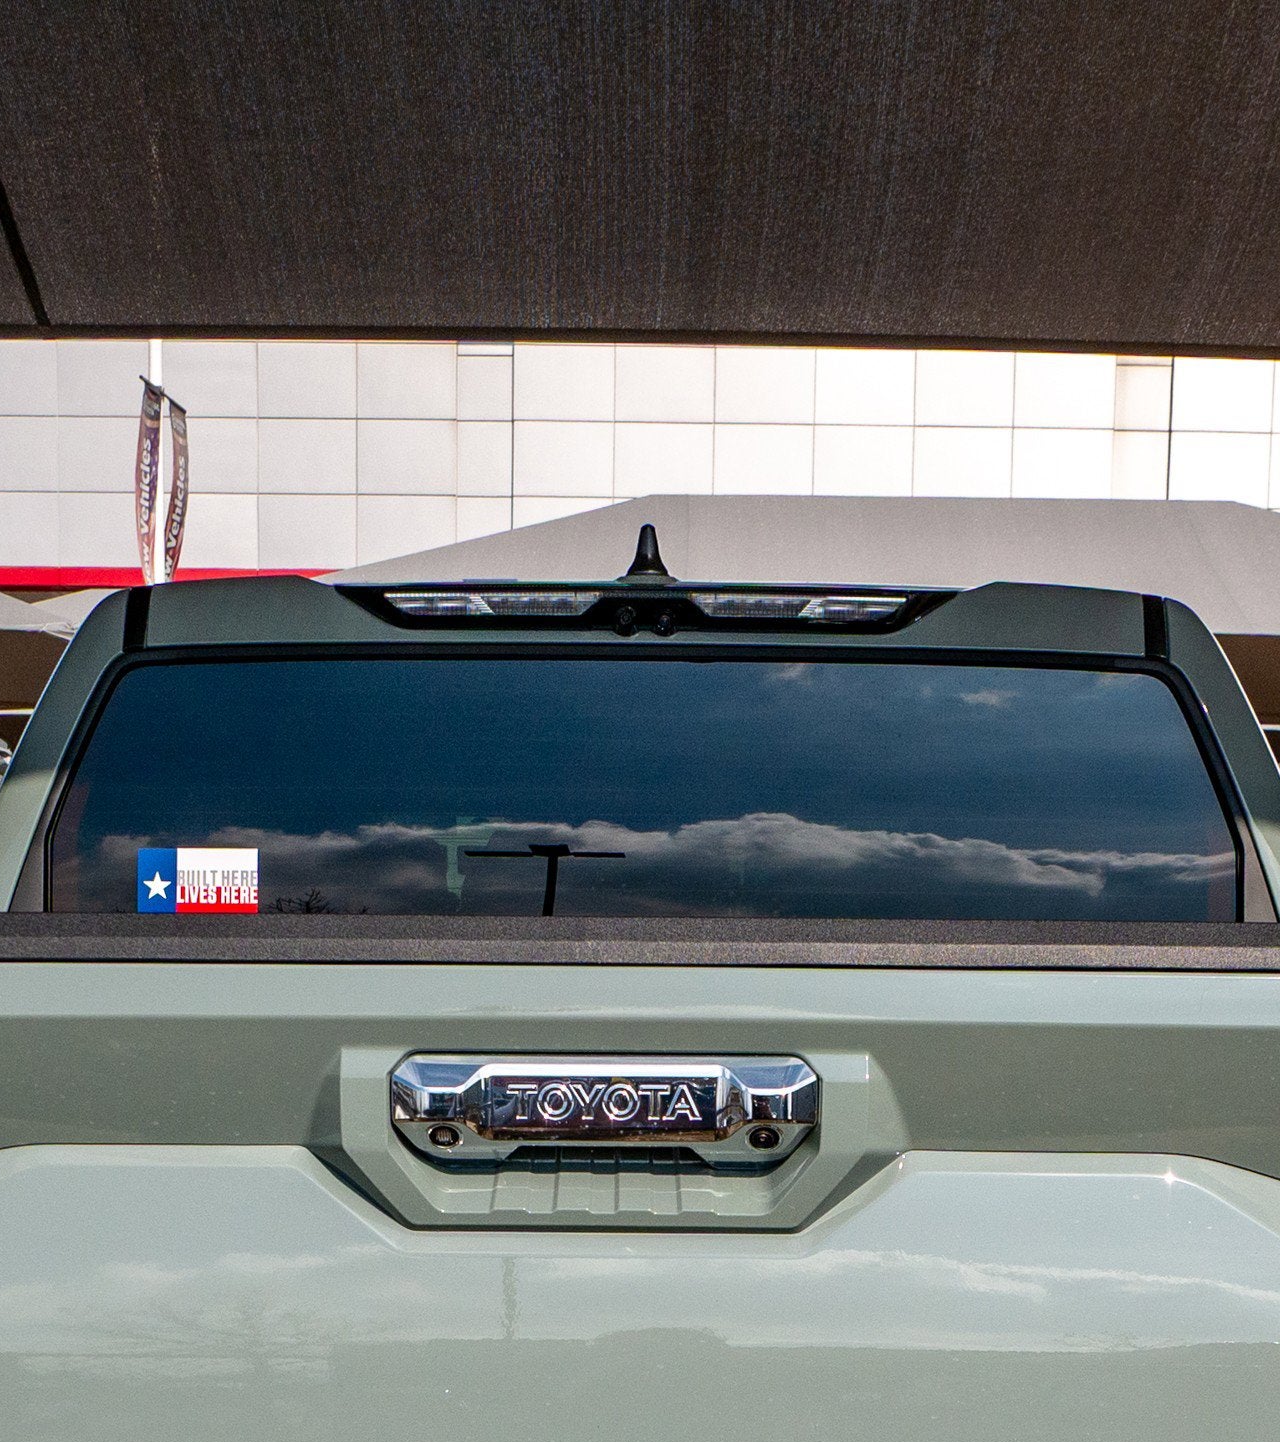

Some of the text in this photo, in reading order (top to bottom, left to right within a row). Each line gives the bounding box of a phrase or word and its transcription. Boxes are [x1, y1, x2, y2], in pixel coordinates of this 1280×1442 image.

[138, 437, 152, 535] Vehicles
[166, 455, 188, 549] Vehicles
[176, 886, 258, 904] LIVES HERE
[178, 870, 258, 886] BUILT HERE
[506, 1083, 702, 1122] TOYOTA
